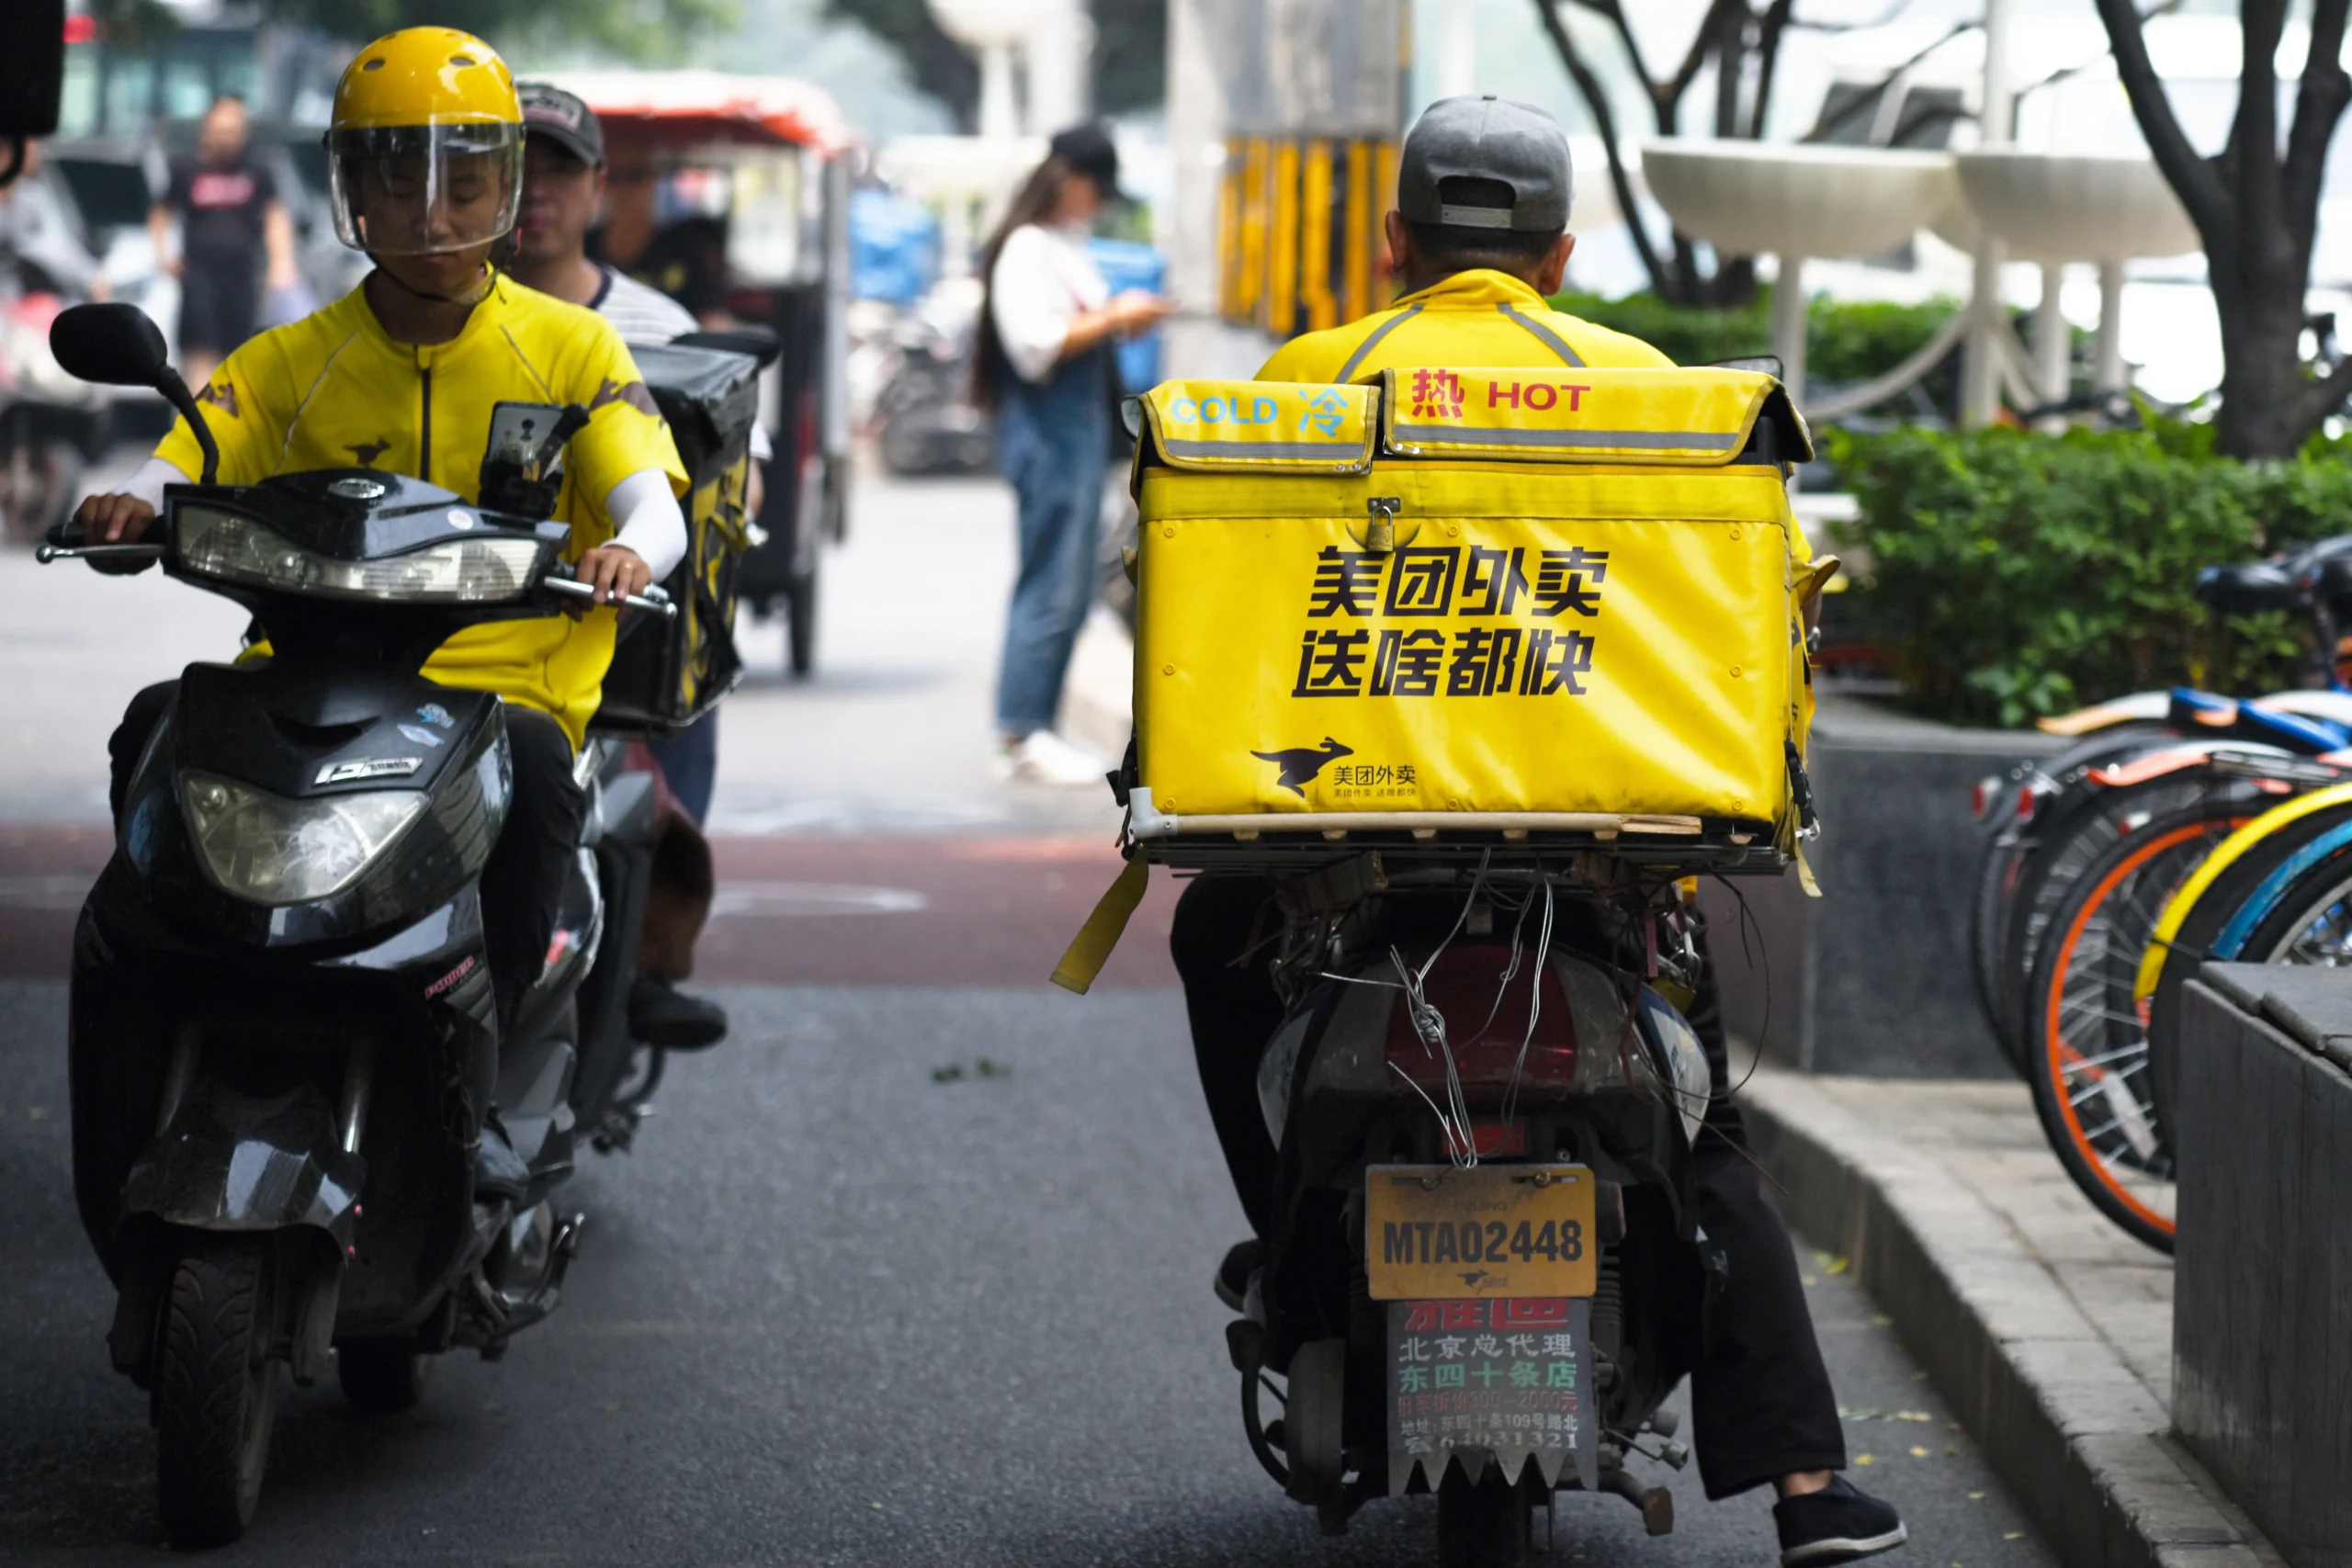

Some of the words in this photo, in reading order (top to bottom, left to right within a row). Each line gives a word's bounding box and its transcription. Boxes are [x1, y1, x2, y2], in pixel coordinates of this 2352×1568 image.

[1172, 397, 1278, 424] COLD
[1298, 389, 1348, 437] 冷
[1412, 369, 1464, 418] 热
[1488, 382, 1590, 412] HOT
[1307, 545, 1610, 617] 美团外卖
[1291, 627, 1595, 697] 送啥都快
[1333, 764, 1416, 785] 美团外卖
[1384, 1219, 1583, 1263] MTA02448
[1399, 1334, 1576, 1361] 北京总代理
[1399, 1360, 1577, 1393] 东四十条店
